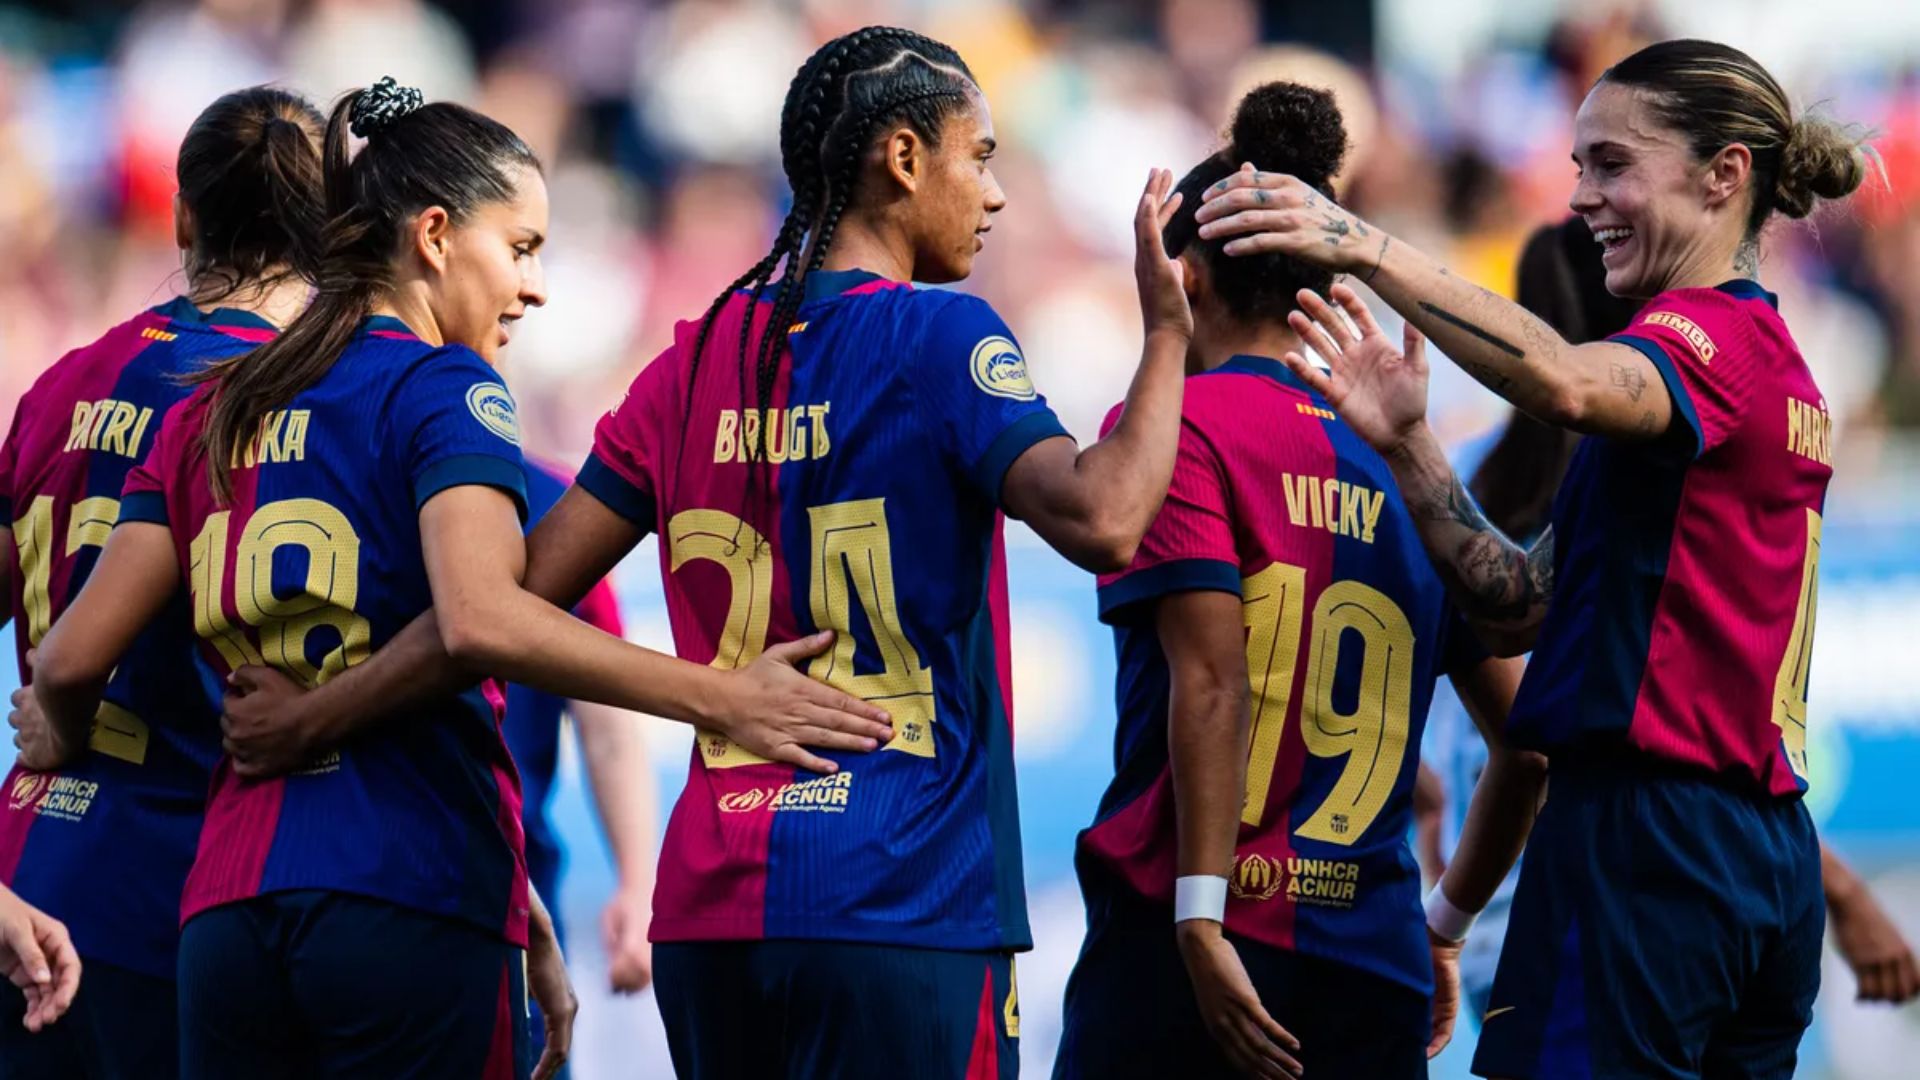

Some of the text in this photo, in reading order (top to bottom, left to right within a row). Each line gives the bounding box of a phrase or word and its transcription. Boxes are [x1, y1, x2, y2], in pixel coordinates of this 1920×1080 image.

[1645, 314, 1715, 363] BIMBO
[1282, 472, 1385, 544] VICKY
[190, 497, 371, 690] 18
[668, 497, 937, 769] 24
[1241, 561, 1417, 846] 19
[48, 776, 99, 799] UNHCR
[777, 771, 853, 792] UNHCR
[36, 793, 90, 815] ACNUR
[768, 787, 849, 805] ACNUR
[1287, 857, 1359, 881] UNHCR
[1286, 877, 1357, 900] ACNUR
